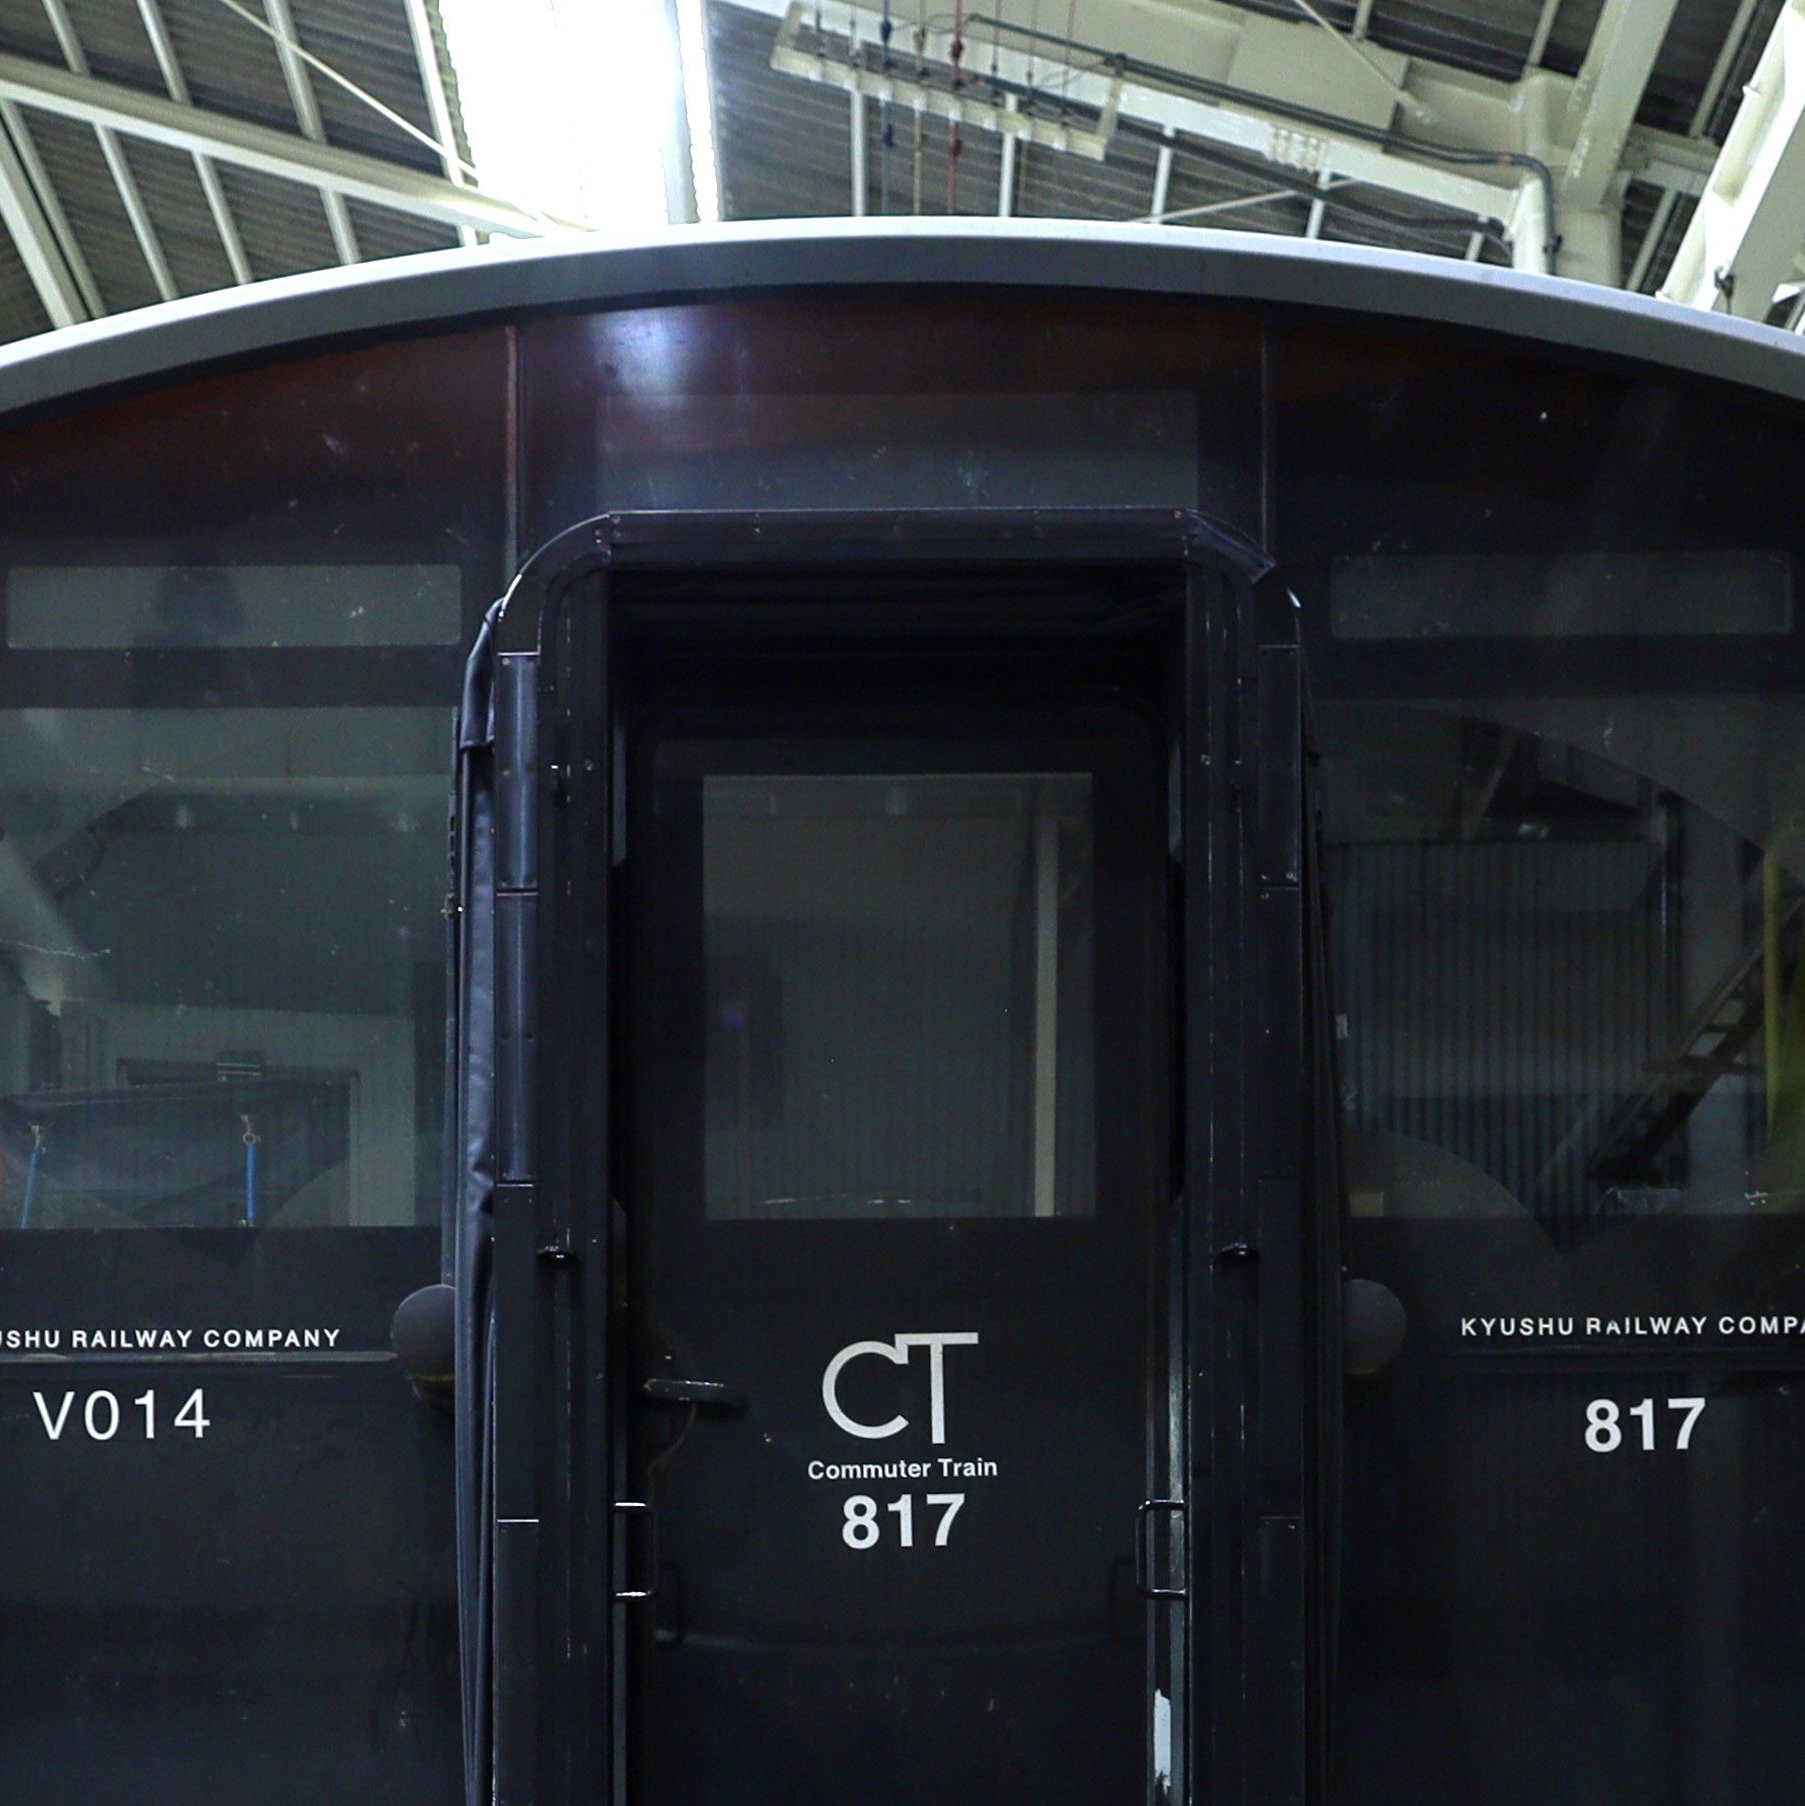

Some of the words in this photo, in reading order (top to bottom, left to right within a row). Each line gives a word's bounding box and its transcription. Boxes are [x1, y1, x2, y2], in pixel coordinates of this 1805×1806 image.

[72, 1329, 193, 1348] RAILWAY
[203, 1328, 340, 1348] COMPANY
[1462, 1317, 1573, 1336] KYUSHU
[1586, 1316, 1707, 1335] RAILWAY
[33, 1388, 211, 1440] V014
[822, 1332, 979, 1445] CT
[1584, 1397, 1706, 1453] 817
[807, 1457, 932, 1480] Commuter
[937, 1457, 998, 1480] Train
[842, 1493, 965, 1550] 817
